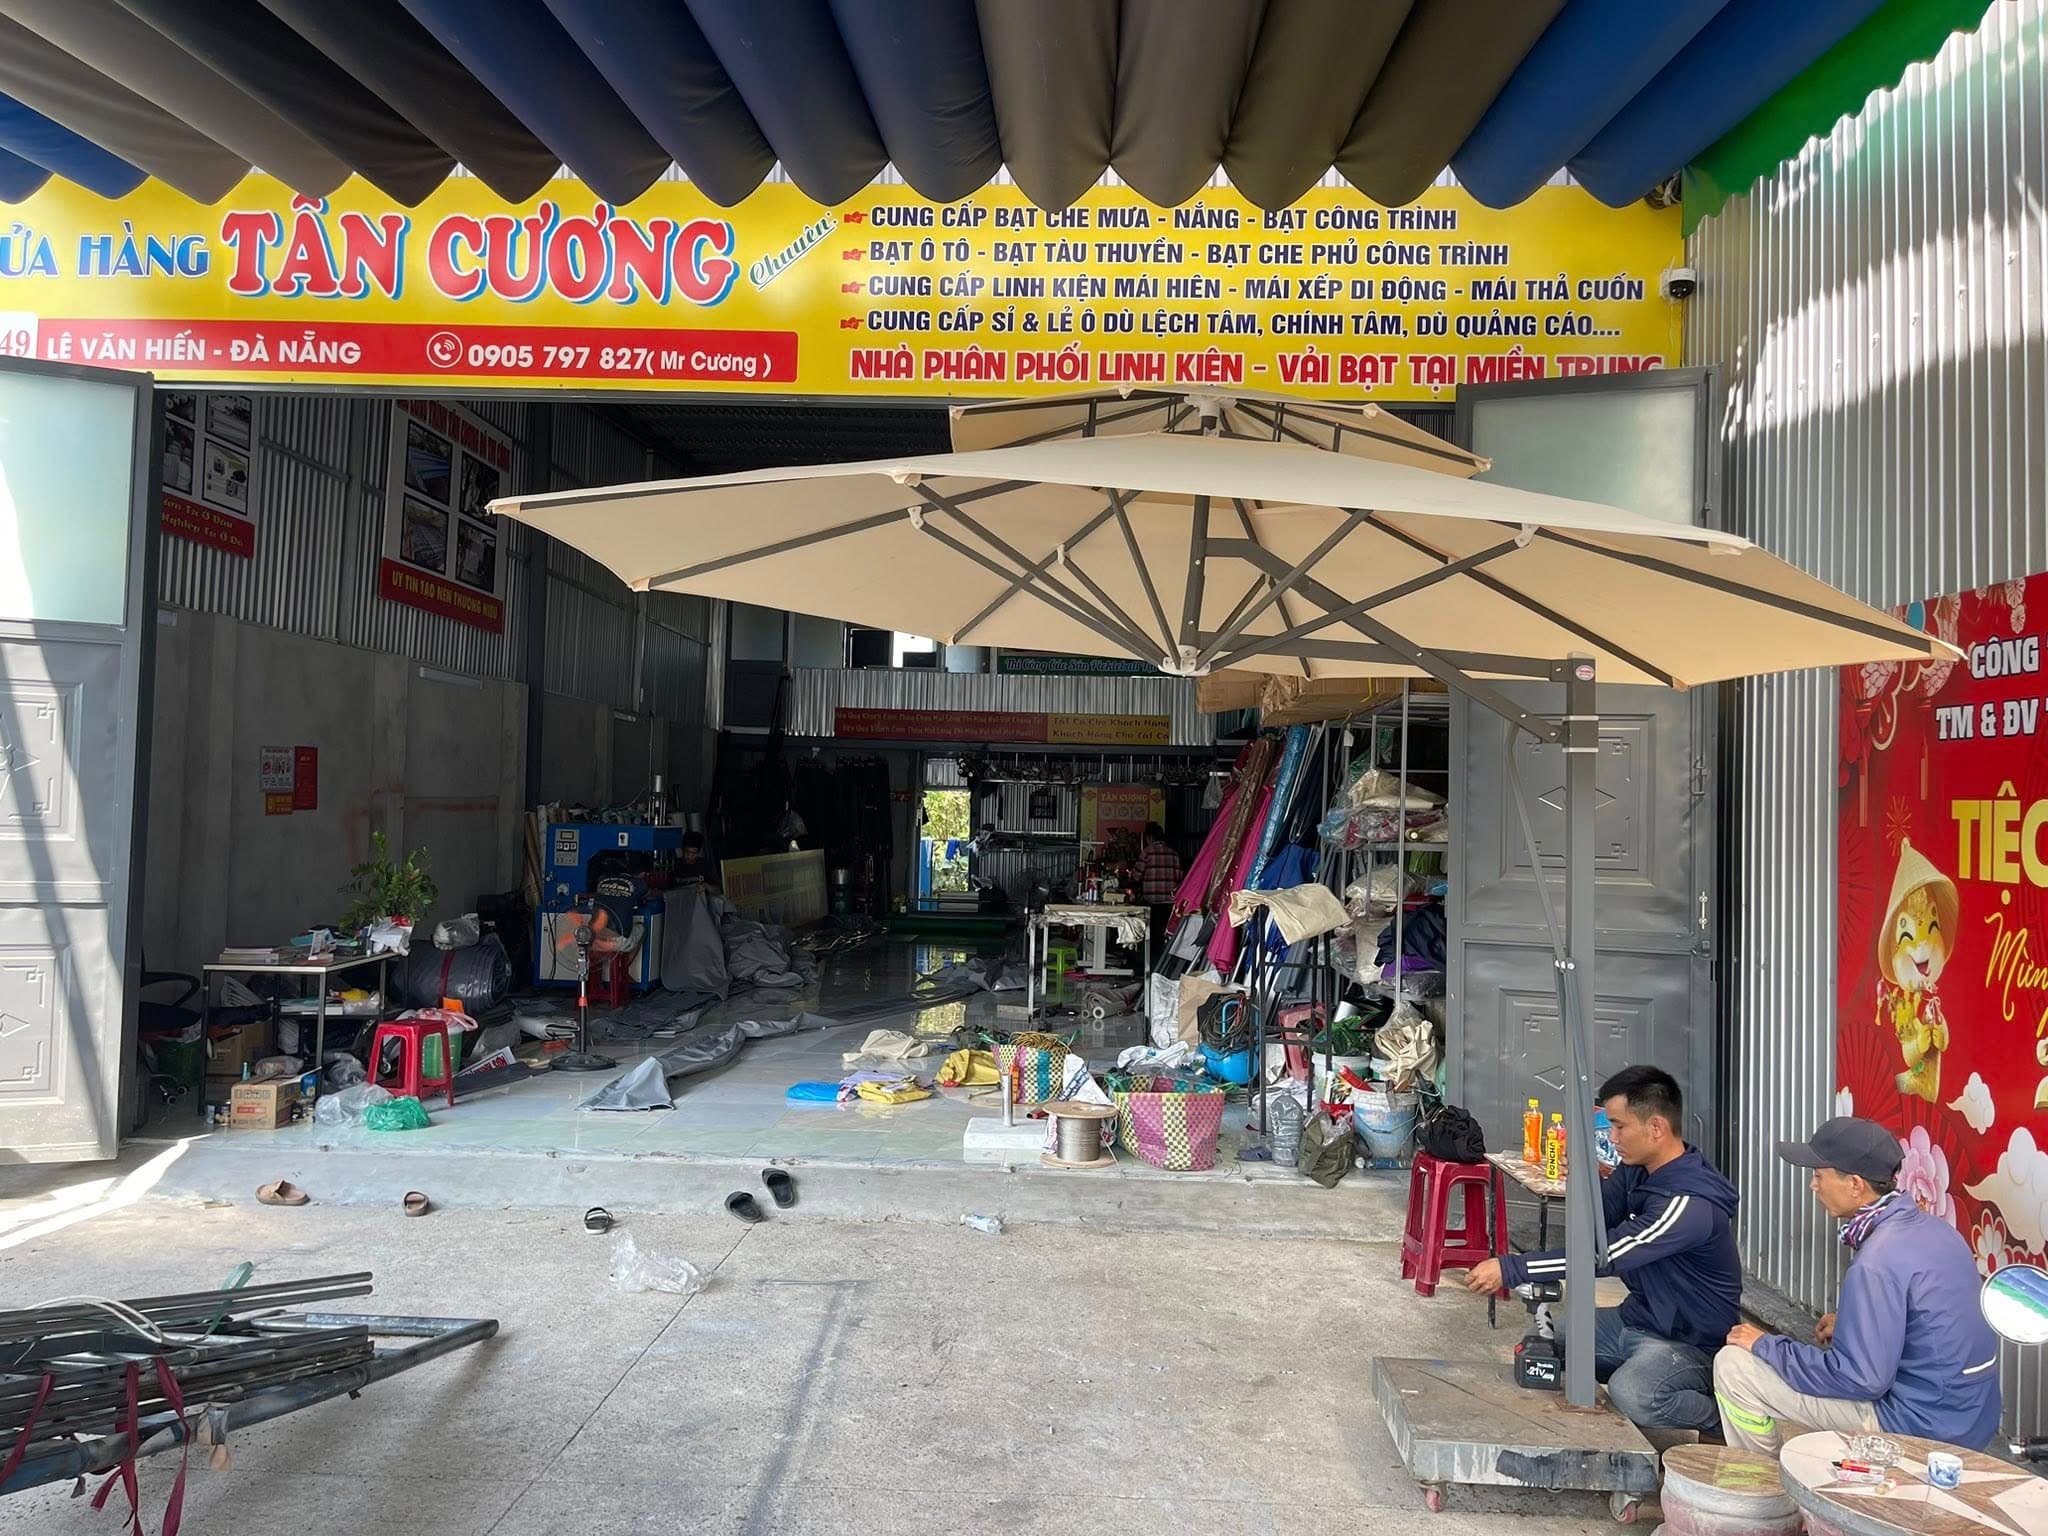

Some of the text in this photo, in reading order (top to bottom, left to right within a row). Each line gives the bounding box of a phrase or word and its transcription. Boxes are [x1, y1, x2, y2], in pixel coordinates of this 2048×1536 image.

[872, 207, 934, 227] CUNG
[943, 200, 987, 227] CẤP
[995, 208, 1036, 232] BẠT
[1046, 209, 1089, 228] CHE
[1098, 207, 1150, 228] MƯA
[1175, 202, 1239, 229] NẮNG
[1264, 209, 1307, 234] BẠT
[1315, 205, 1379, 229] CÔNG
[1388, 206, 1457, 230] TRÌNH
[79, 222, 209, 277] HÀNG
[221, 193, 408, 300] TÂN
[428, 201, 740, 305] CƯƠNG
[870, 242, 913, 265] BẠT
[921, 239, 935, 261] Ô
[943, 239, 970, 261] TÔ
[994, 243, 1036, 267] BẠT
[1045, 239, 1087, 263] TÀU
[1096, 237, 1183, 263] THUYỀN
[1207, 244, 1251, 268] BẠT
[1259, 244, 1302, 264] CHE
[1312, 238, 1358, 265] PHỦ
[1367, 241, 1430, 265] CÔNG
[1440, 241, 1508, 265] TRÌNH
[870, 276, 931, 296] CUNG
[940, 270, 984, 297] CẤP
[993, 278, 1045, 297] LINH
[1053, 275, 1106, 301] KIỆN
[1114, 274, 1158, 298] MÁI
[1166, 275, 1220, 298] HIÊN
[1245, 275, 1290, 299] MÁI
[1299, 273, 1343, 300] XẾP
[1351, 280, 1374, 300] DI
[1382, 276, 1446, 305] ĐỘNG
[1471, 276, 1517, 300] MÁI
[1526, 273, 1569, 300] THẢ
[1578, 272, 1643, 300] CUỐN
[868, 304, 1621, 339] CUNG CẤP SỈ & LẺ Ô DÙ LỆCH TÂM, CHÍNH TÂM, DÙ QUẢNG CÁO....
[48, 331, 72, 360] LÊ
[80, 332, 136, 361] VĂN
[145, 330, 206, 362] HIẾN
[230, 334, 270, 362] ĐÀ
[279, 330, 362, 365] NẴNG
[468, 345, 534, 368] 0905
[543, 347, 590, 369] 797
[661, 351, 685, 371] Mr
[691, 351, 757, 378] Cương
[851, 343, 914, 380] NHÀ
[924, 345, 1006, 380] PHÂN
[1016, 341, 1089, 382] PHỐI
[1099, 353, 1165, 382] LINH
[1278, 346, 1329, 384] VẢI
[1339, 354, 1398, 391] BẠT
[1408, 355, 1456, 391] TẠI
[1467, 345, 1545, 384] MIỀN
[1971, 635, 2039, 680] CÔNG
[1936, 705, 1977, 740] TM
[1981, 703, 1996, 737] &
[2002, 698, 2039, 737] ĐV
